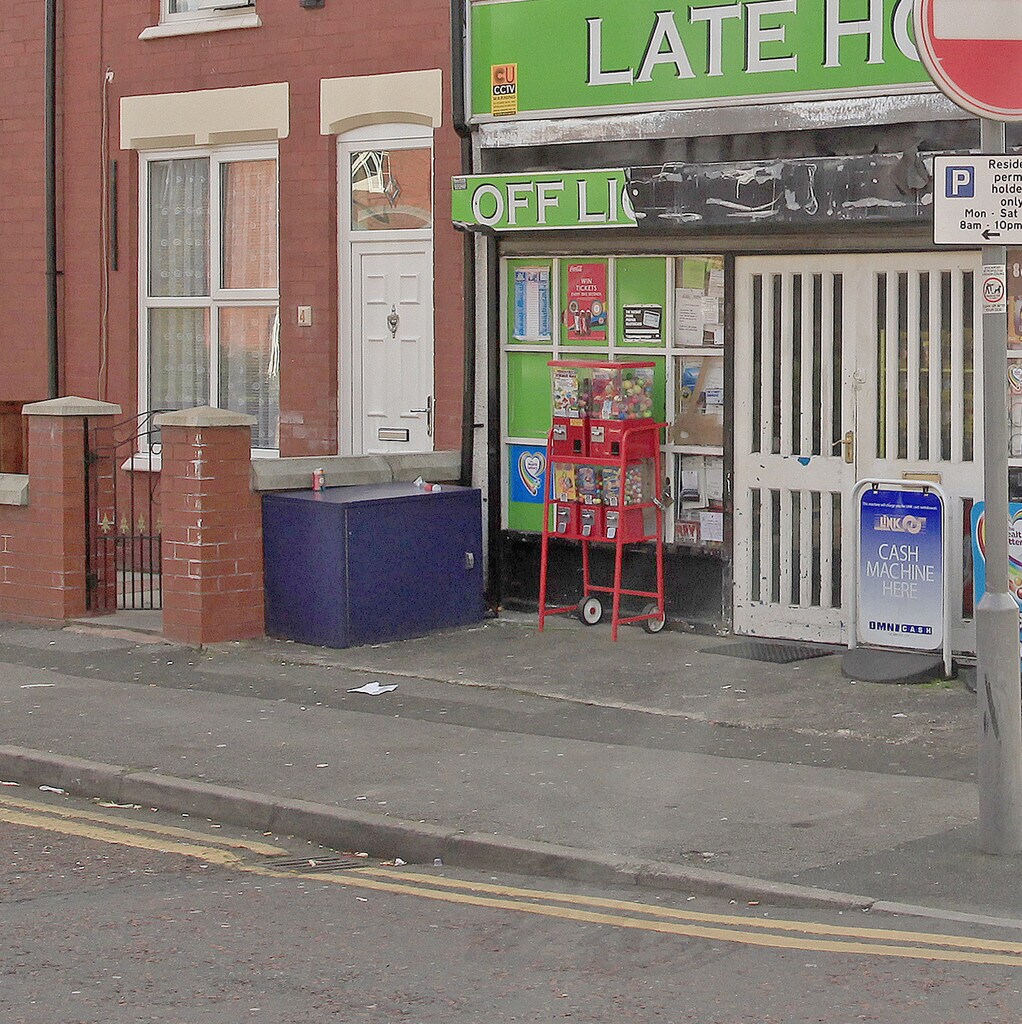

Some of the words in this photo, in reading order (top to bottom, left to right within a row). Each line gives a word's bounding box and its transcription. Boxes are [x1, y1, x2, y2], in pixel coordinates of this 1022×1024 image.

[493, 84, 516, 95] CCTV
[952, 169, 970, 195] P
[471, 179, 564, 227] OFF
[964, 209, 987, 218] Mon
[1000, 209, 1018, 218] Sat
[960, 221, 982, 230] 8am
[994, 221, 1022, 231] 10pm
[1013, 262, 1020, 278] 8
[880, 515, 901, 529] LINK
[878, 543, 919, 562] CASH
[866, 561, 934, 582] MACHINE
[882, 580, 918, 599] HERE
